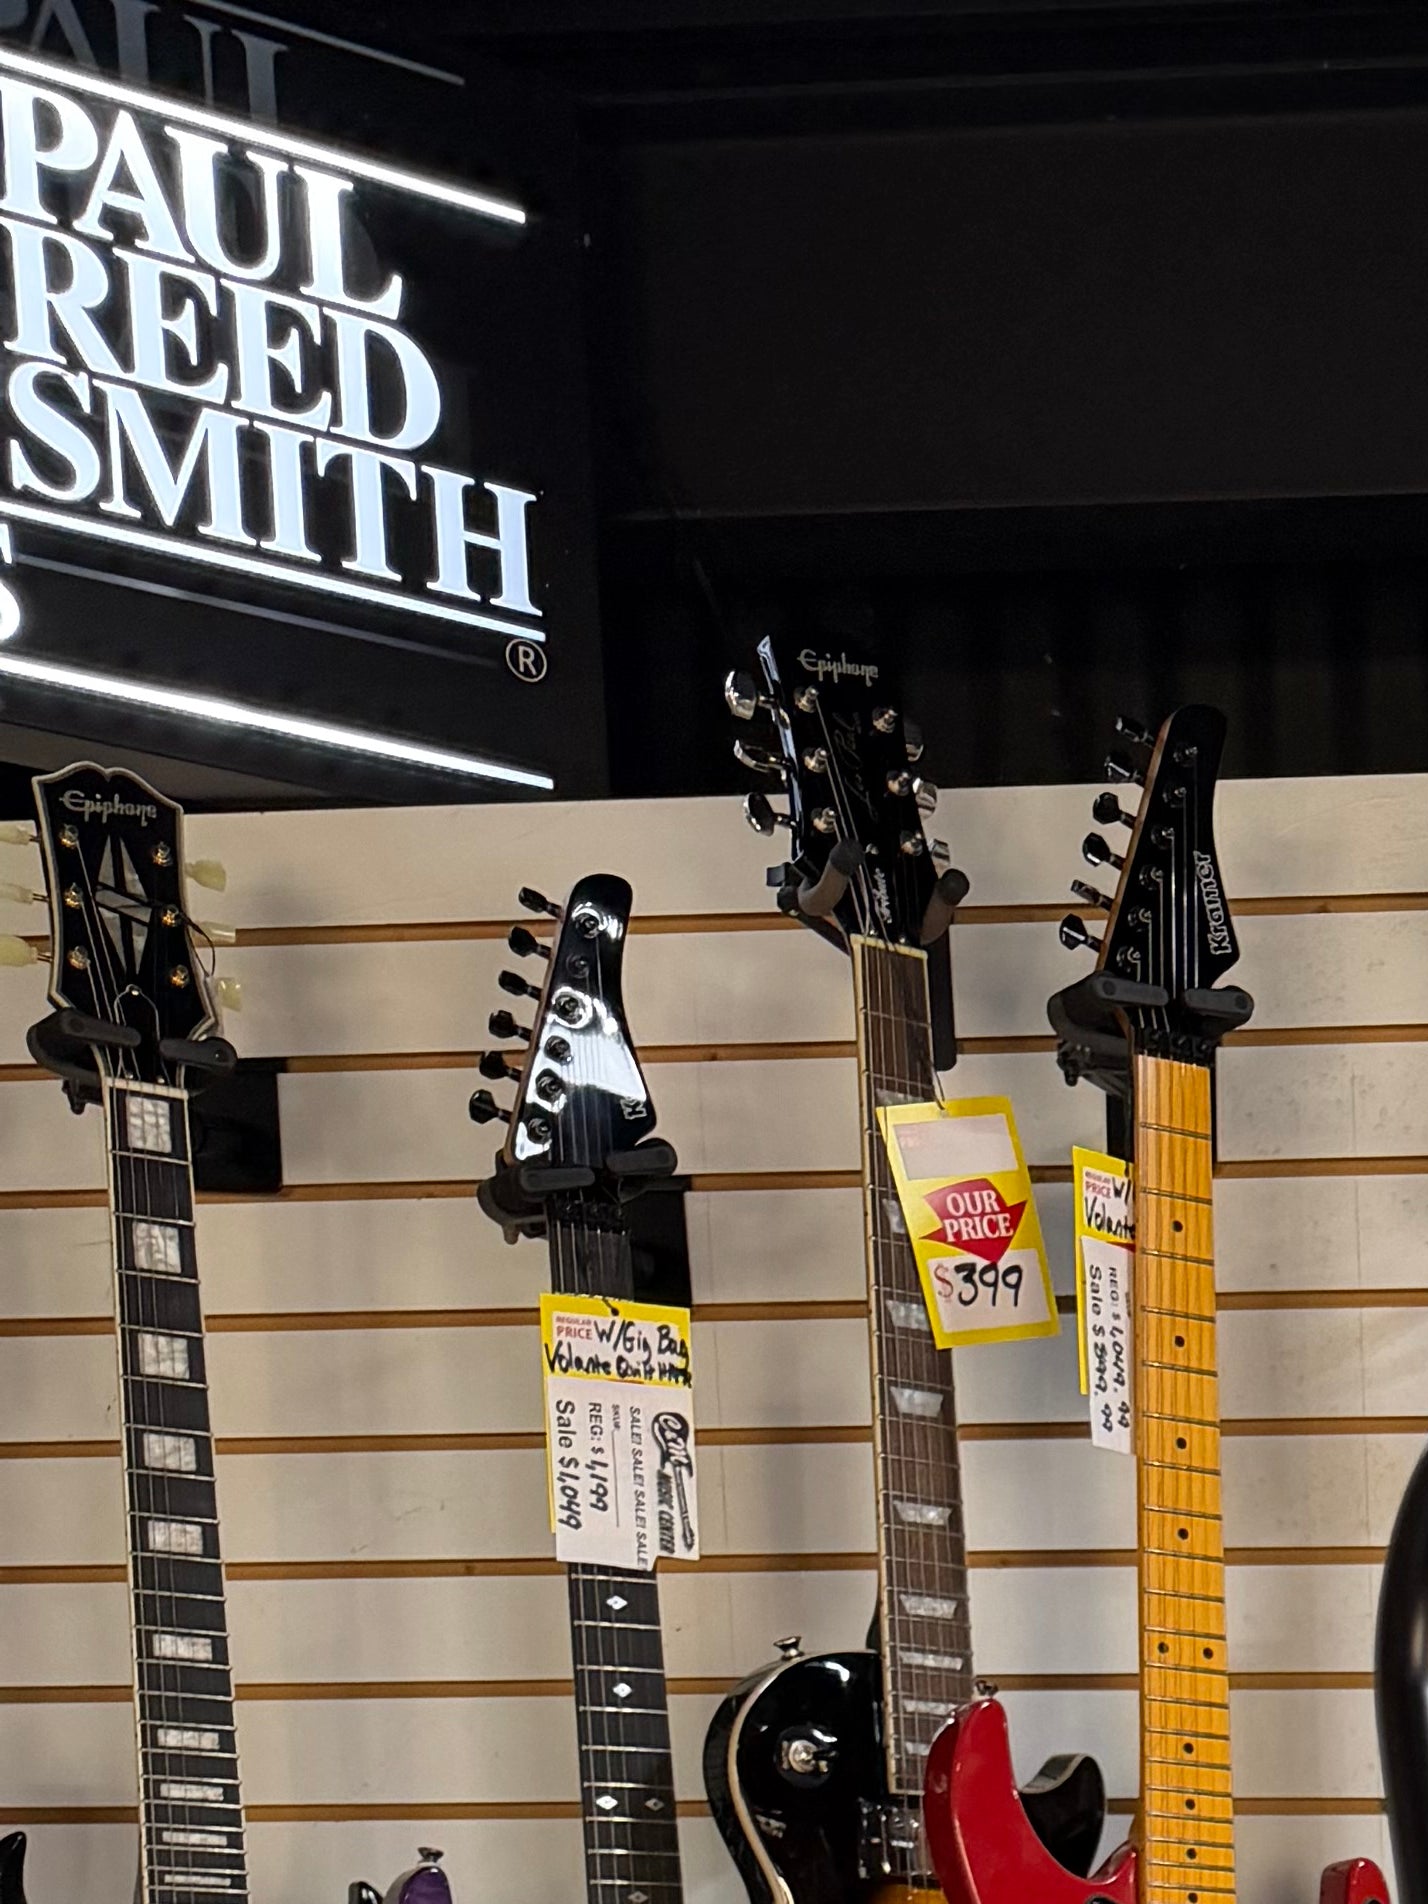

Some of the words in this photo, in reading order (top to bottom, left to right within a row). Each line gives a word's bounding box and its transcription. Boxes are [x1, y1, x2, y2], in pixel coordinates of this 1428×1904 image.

[0, 74, 402, 319] PAUL
[0, 213, 442, 451] REED
[7, 362, 543, 617] SMITH
[798, 649, 879, 687] Epiphone
[62, 790, 157, 827] Epiphone
[1195, 852, 1233, 955] Kramer
[946, 1188, 1000, 1217] OUR
[944, 1213, 1014, 1243] PRICE
[933, 1261, 1024, 1308] $399
[1089, 1265, 1102, 1316] Sale
[545, 1340, 611, 1375] Volante
[556, 1327, 593, 1341] PRICE
[657, 1324, 691, 1372] Bag
[555, 1399, 577, 1449] Sale
[588, 1402, 604, 1441] REG:
[629, 1406, 642, 1445] SALE!
[632, 1447, 645, 1486] SALE!
[633, 1490, 647, 1529] SALE!
[658, 1510, 676, 1555] CENTER
